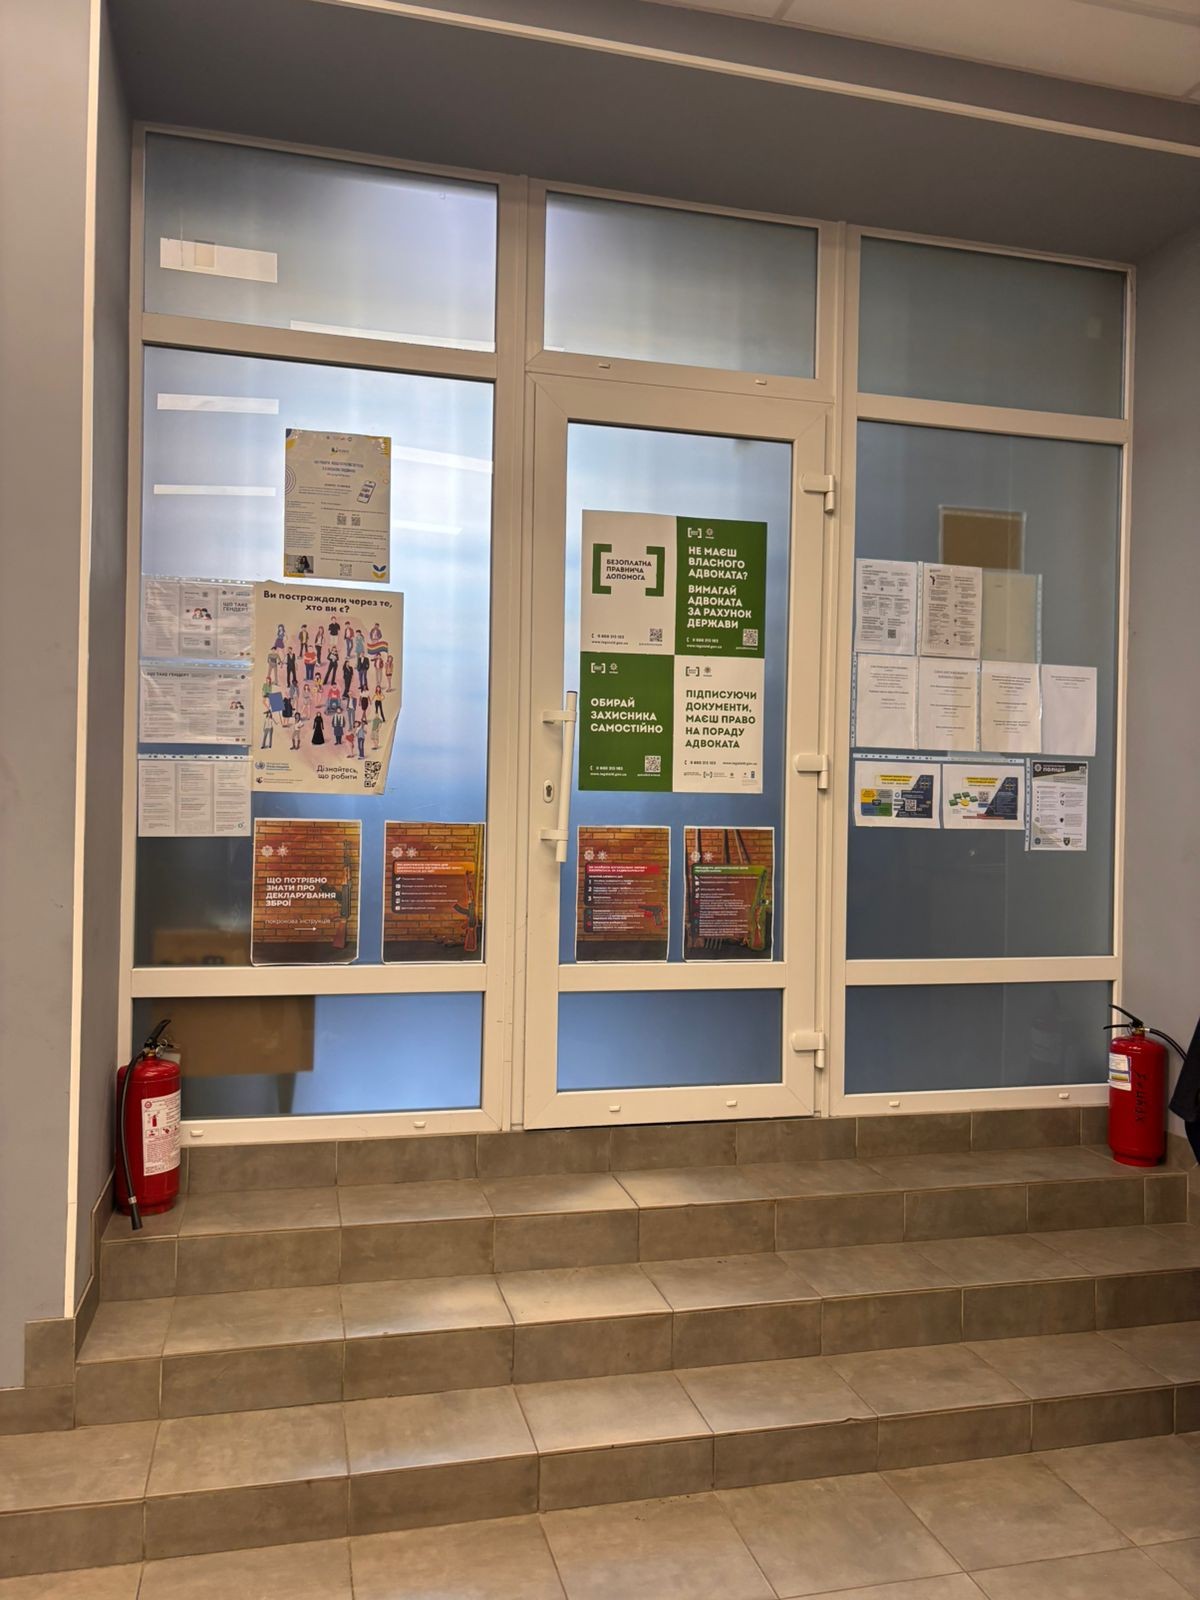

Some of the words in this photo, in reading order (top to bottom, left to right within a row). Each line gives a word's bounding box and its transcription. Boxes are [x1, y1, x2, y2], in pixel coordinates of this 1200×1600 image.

[688, 546, 701, 555] НЕ
[704, 548, 737, 558] МАЄШ
[688, 558, 745, 569] ВЛАСНОГО
[688, 569, 748, 580] АДВОКАТА?
[688, 584, 737, 596] ВИМАГАЙ
[263, 590, 277, 599] Ви
[278, 592, 347, 604] постраждали
[349, 599, 378, 608] через
[688, 597, 742, 607] АДВОКАТА
[305, 604, 323, 612] хто
[339, 605, 350, 613] є?
[688, 608, 701, 616] ЗА
[704, 608, 752, 619] РАХУНОК
[687, 619, 738, 629] ДЕРЖАВИ
[686, 690, 757, 700] ПІДПИСУЮЧИ
[591, 697, 635, 708] ОБИРАЙ
[686, 702, 752, 712] ДОКУМЕНТИ,
[591, 711, 657, 721] ЗАХИСНИКА
[686, 715, 719, 723] МАЄШ
[722, 716, 756, 724] ПРАВО
[590, 722, 663, 733] САМОСТІЙНО
[686, 727, 702, 735] НА
[702, 727, 744, 736] ПОРАДУ
[685, 740, 740, 749] АДВОКАТА
[316, 766, 358, 774] Дізнайтесь,
[331, 774, 357, 782] робити
[265, 898, 292, 906] ЗБРОЇ
